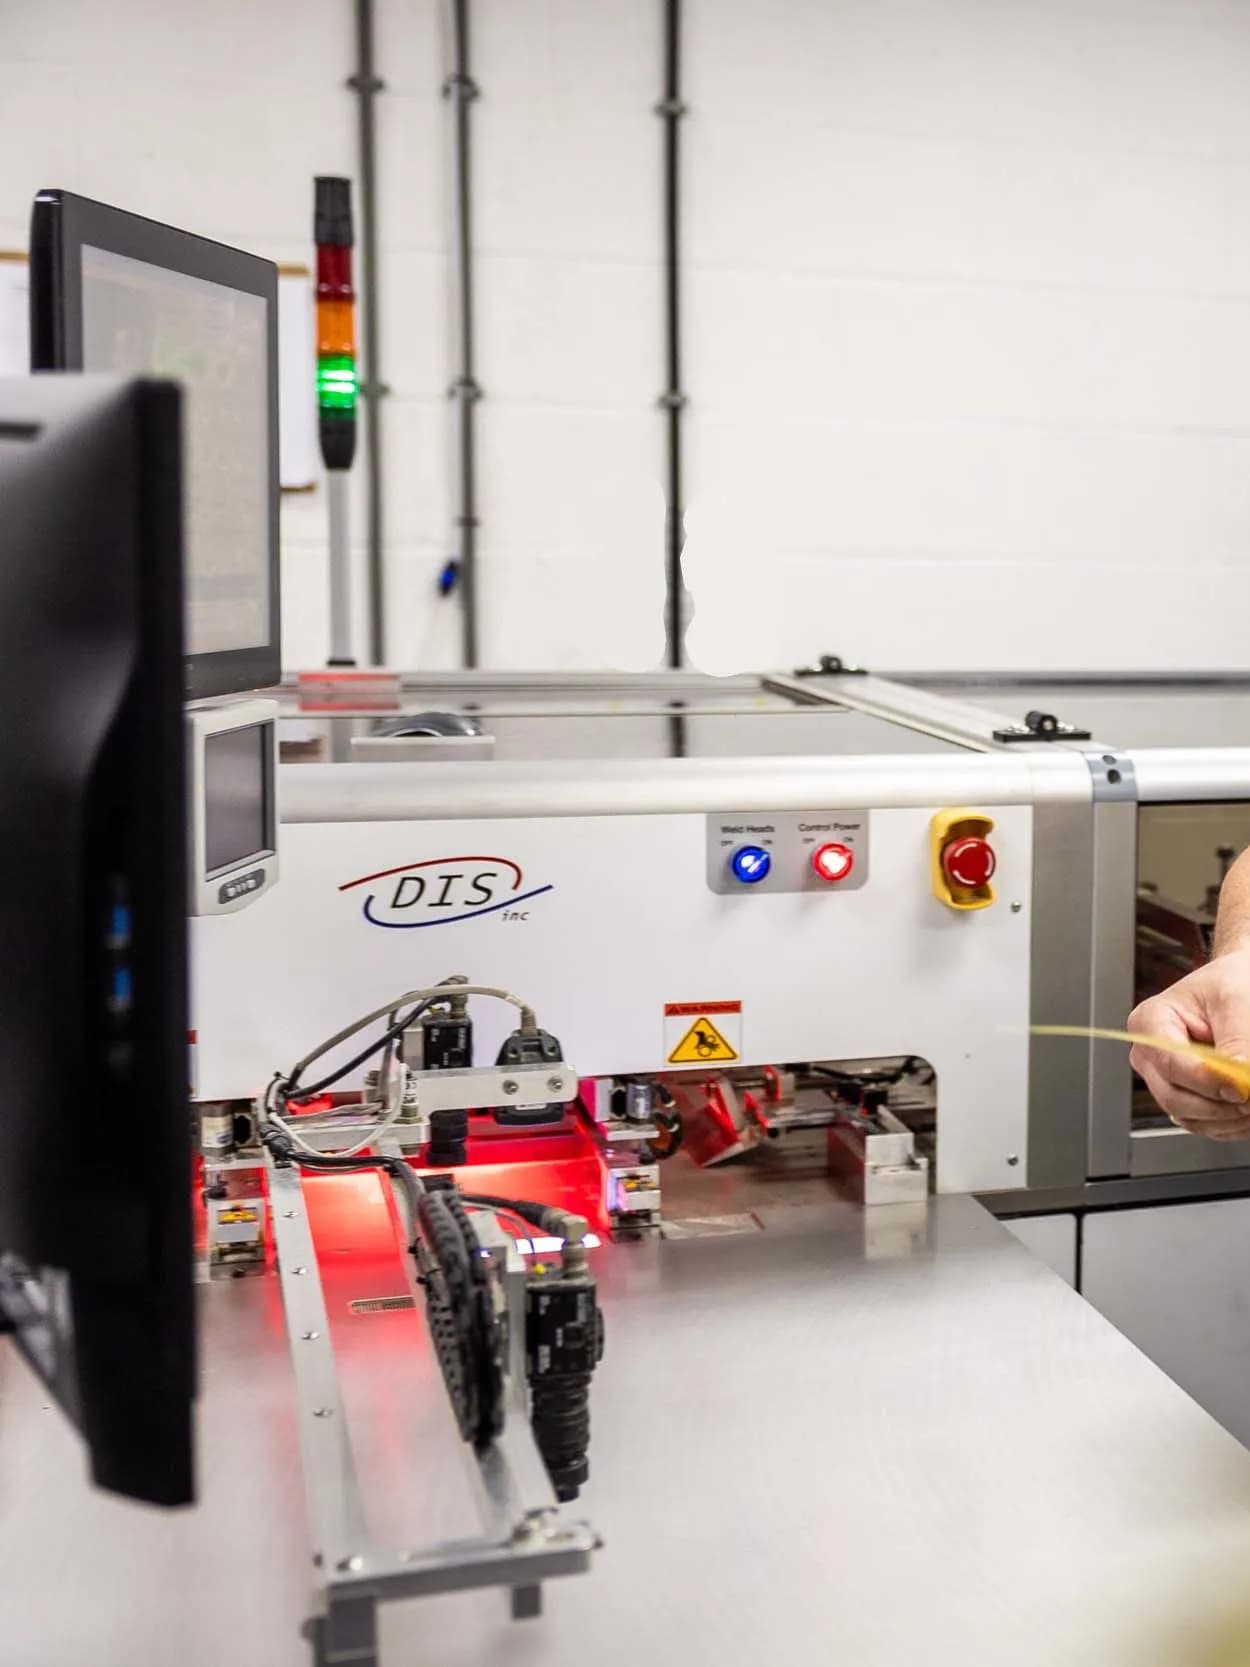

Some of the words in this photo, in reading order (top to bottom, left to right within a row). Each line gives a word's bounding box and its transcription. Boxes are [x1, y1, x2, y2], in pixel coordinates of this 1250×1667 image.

[798, 823, 831, 832] Control
[833, 822, 861, 831] Power
[390, 873, 498, 909] DIS
[501, 909, 530, 921] inc
